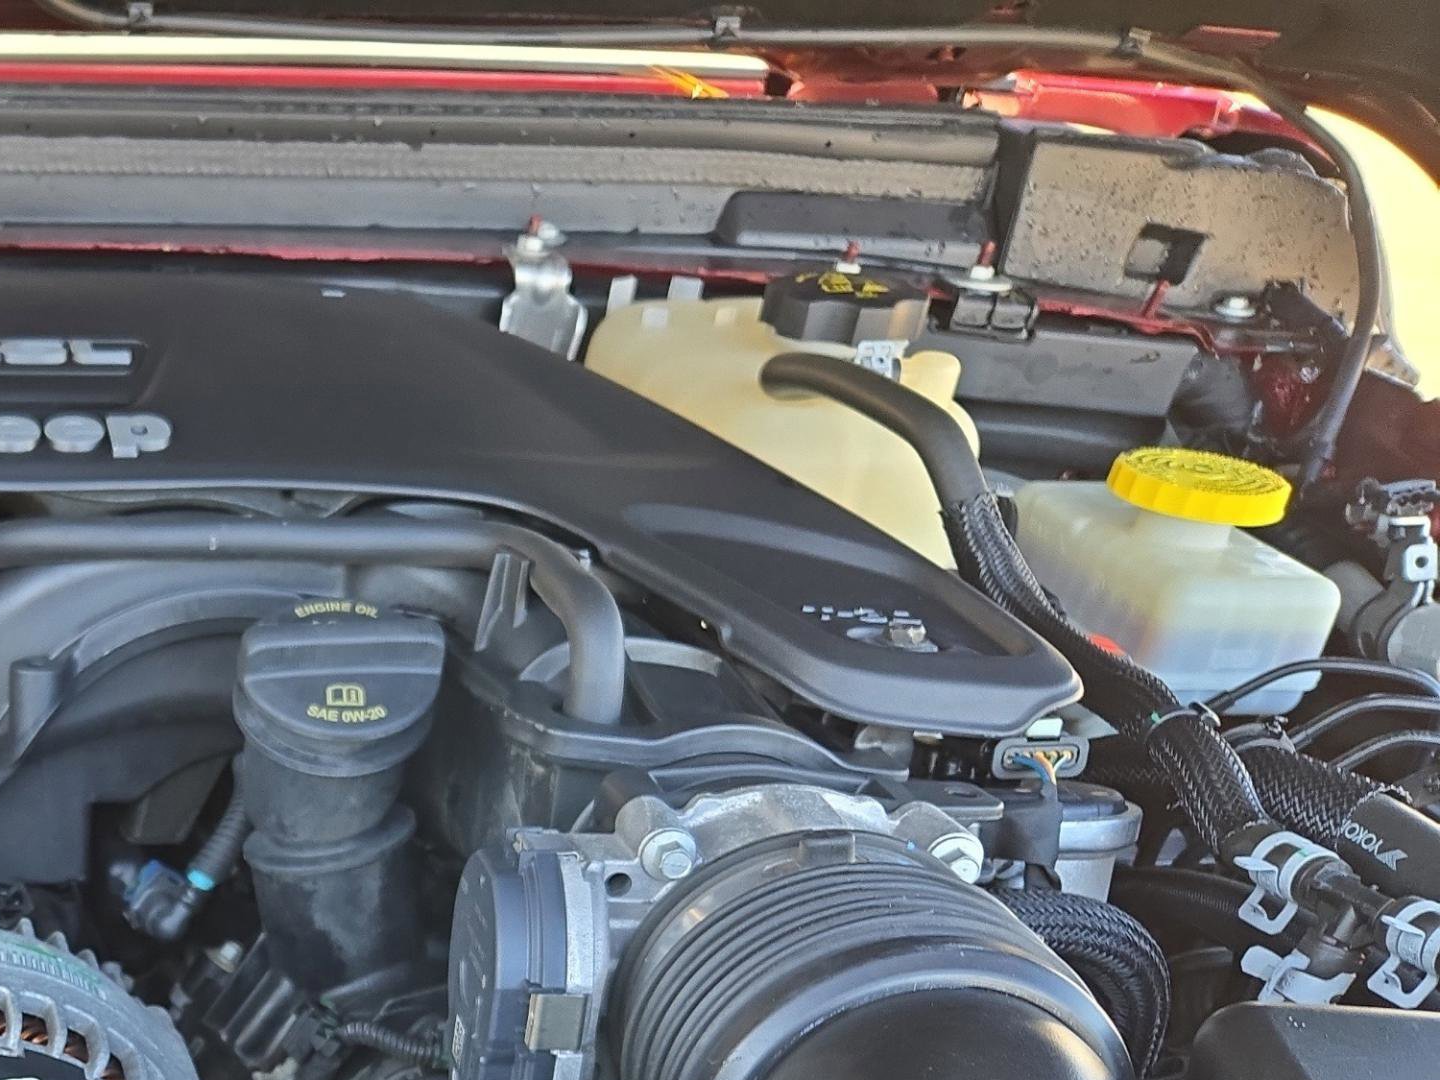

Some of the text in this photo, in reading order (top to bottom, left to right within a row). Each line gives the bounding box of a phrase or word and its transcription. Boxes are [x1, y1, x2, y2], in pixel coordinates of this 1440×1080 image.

[294, 601, 379, 618] ENGINE OIL
[306, 704, 339, 722] SAE
